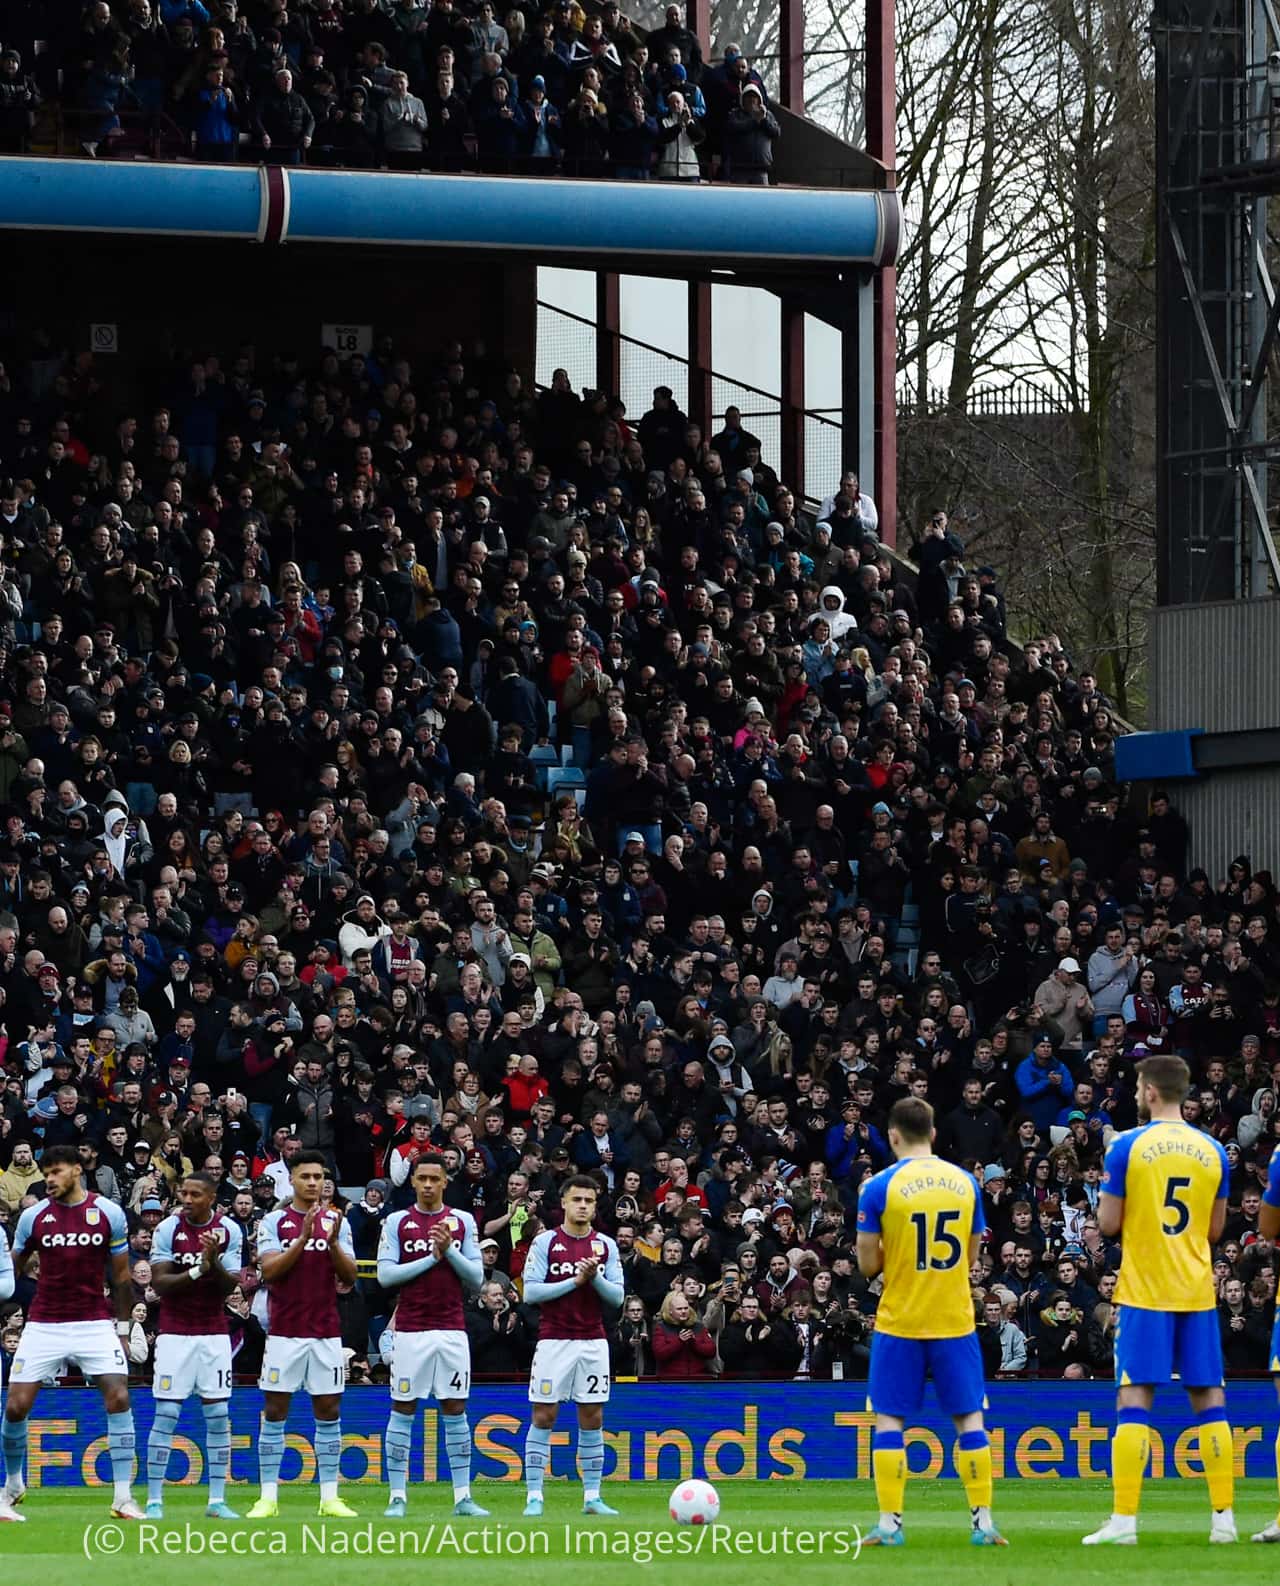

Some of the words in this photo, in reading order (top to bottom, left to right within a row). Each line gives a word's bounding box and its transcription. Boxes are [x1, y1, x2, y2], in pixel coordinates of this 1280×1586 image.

[337, 335, 358, 351] L8
[1142, 1140, 1212, 1168] STEPHENS
[900, 1176, 966, 1199] PERRAUD
[1161, 1176, 1191, 1236] 5
[41, 1232, 104, 1247] CAZOO
[404, 1239, 462, 1253] CAZO
[911, 1210, 962, 1271] 15
[173, 1252, 225, 1265] CAZ
[550, 1262, 606, 1275] CAZO
[114, 1349, 126, 1366] 5
[217, 1369, 232, 1389] 18
[333, 1366, 344, 1387] 11
[449, 1371, 468, 1392] 41
[586, 1374, 609, 1394] 23
[26, 1408, 438, 1488] Footbal
